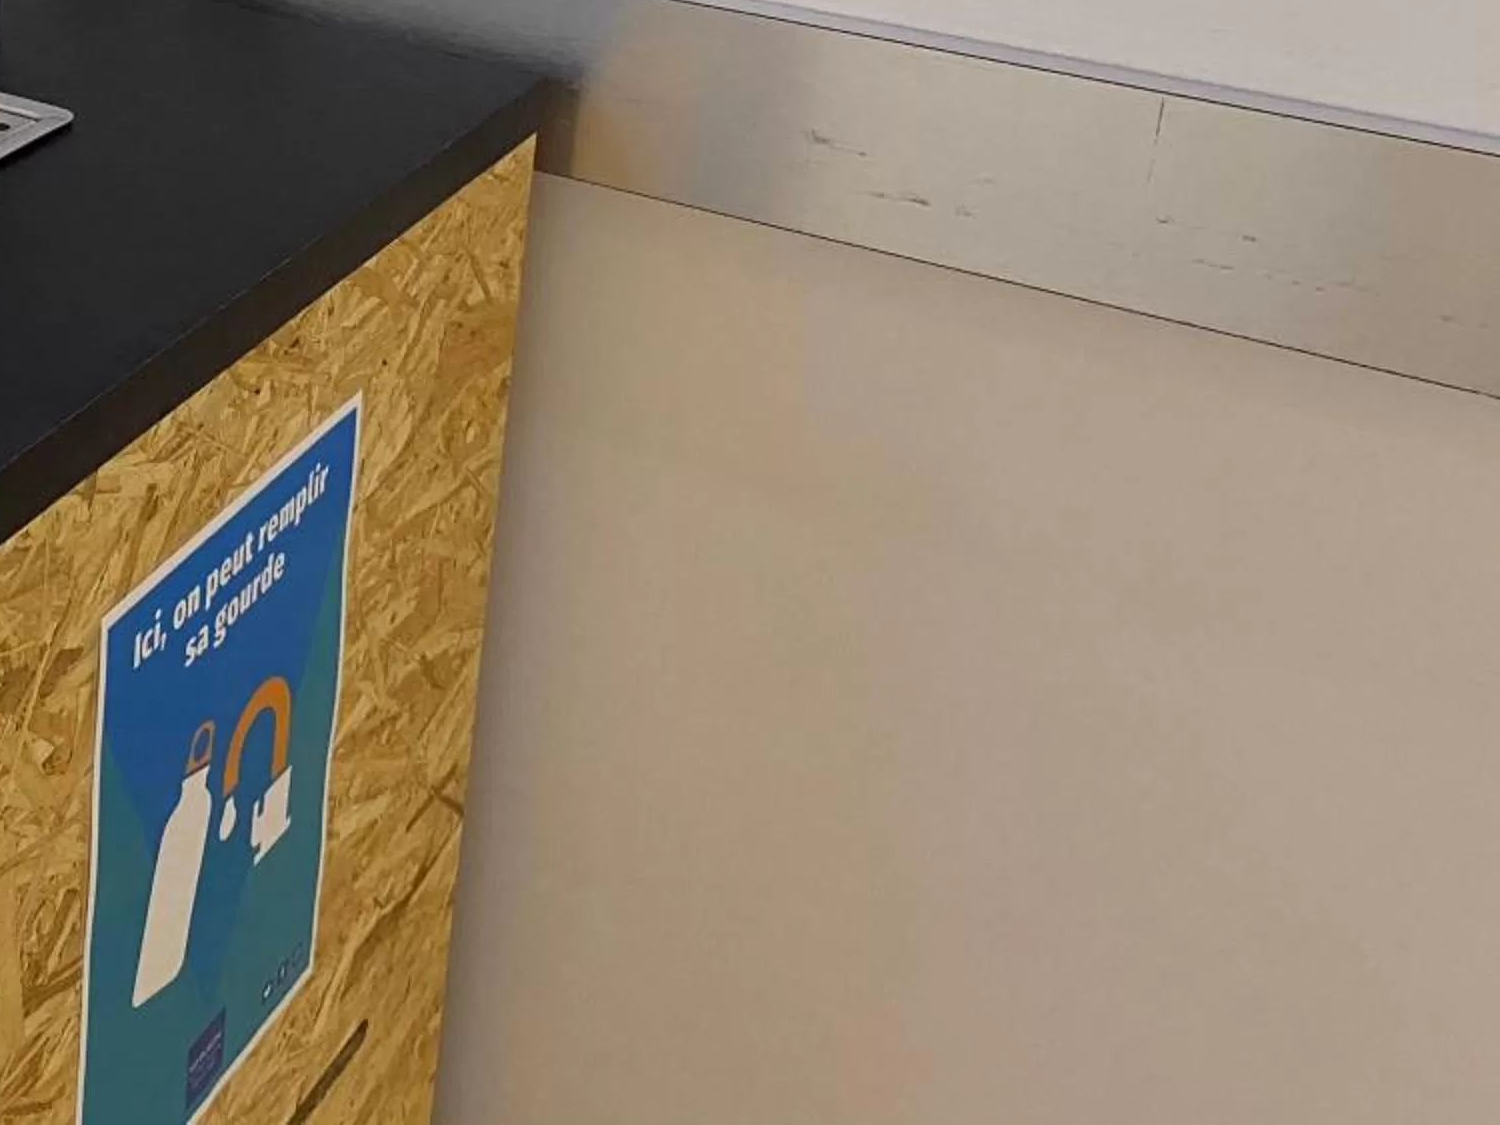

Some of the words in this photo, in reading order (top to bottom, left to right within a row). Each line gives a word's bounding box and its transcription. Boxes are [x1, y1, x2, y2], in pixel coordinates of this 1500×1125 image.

[133, 609, 167, 670] Ici,
[172, 584, 200, 630] on
[205, 531, 254, 611] peut
[258, 462, 329, 552] remplir
[184, 624, 209, 668] sa
[213, 551, 285, 649] gourde
